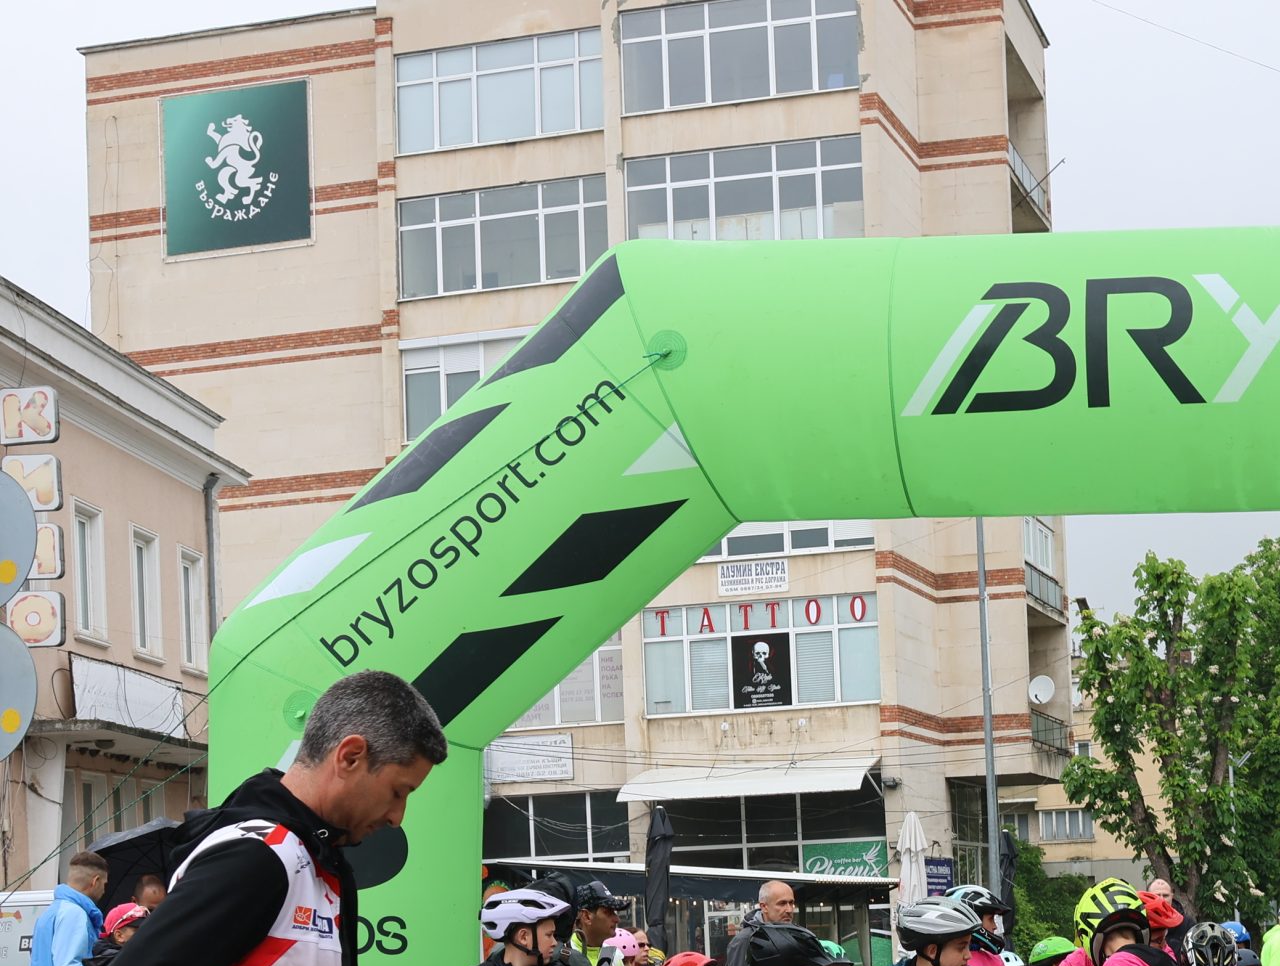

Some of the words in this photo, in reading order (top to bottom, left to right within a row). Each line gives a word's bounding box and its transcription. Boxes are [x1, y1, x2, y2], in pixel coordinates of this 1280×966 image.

[319, 379, 626, 667] bryzosport.com
[720, 563, 753, 579] АЛУМИН
[754, 561, 786, 576] ЕКСТРА
[655, 595, 867, 636] TATTOO
[834, 857, 851, 865] coffee
